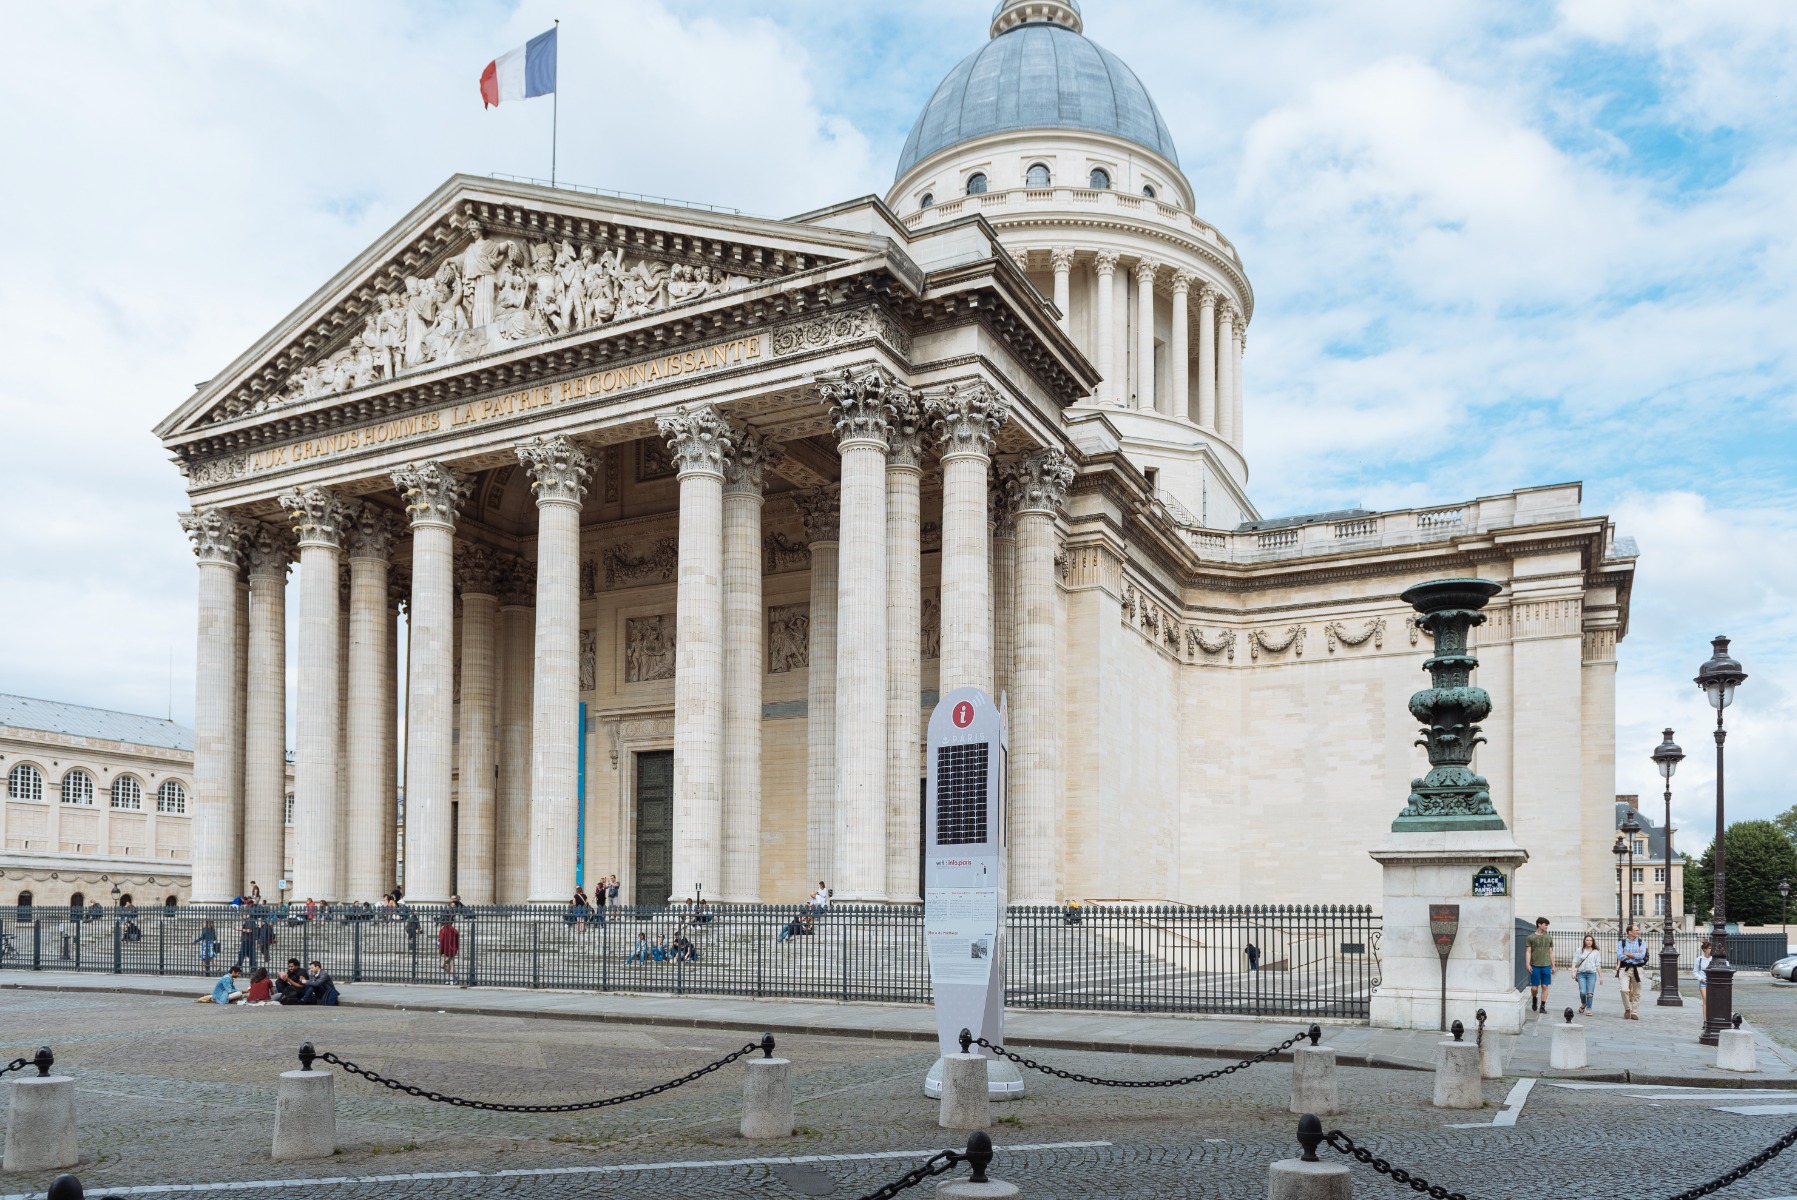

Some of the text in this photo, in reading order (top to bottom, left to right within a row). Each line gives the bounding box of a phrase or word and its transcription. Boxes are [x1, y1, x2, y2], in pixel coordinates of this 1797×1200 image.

[252, 335, 761, 471] AUX GRANDS HOMMES LA PATRIE RECONNAISSANTE
[953, 733, 985, 743] PARIS
